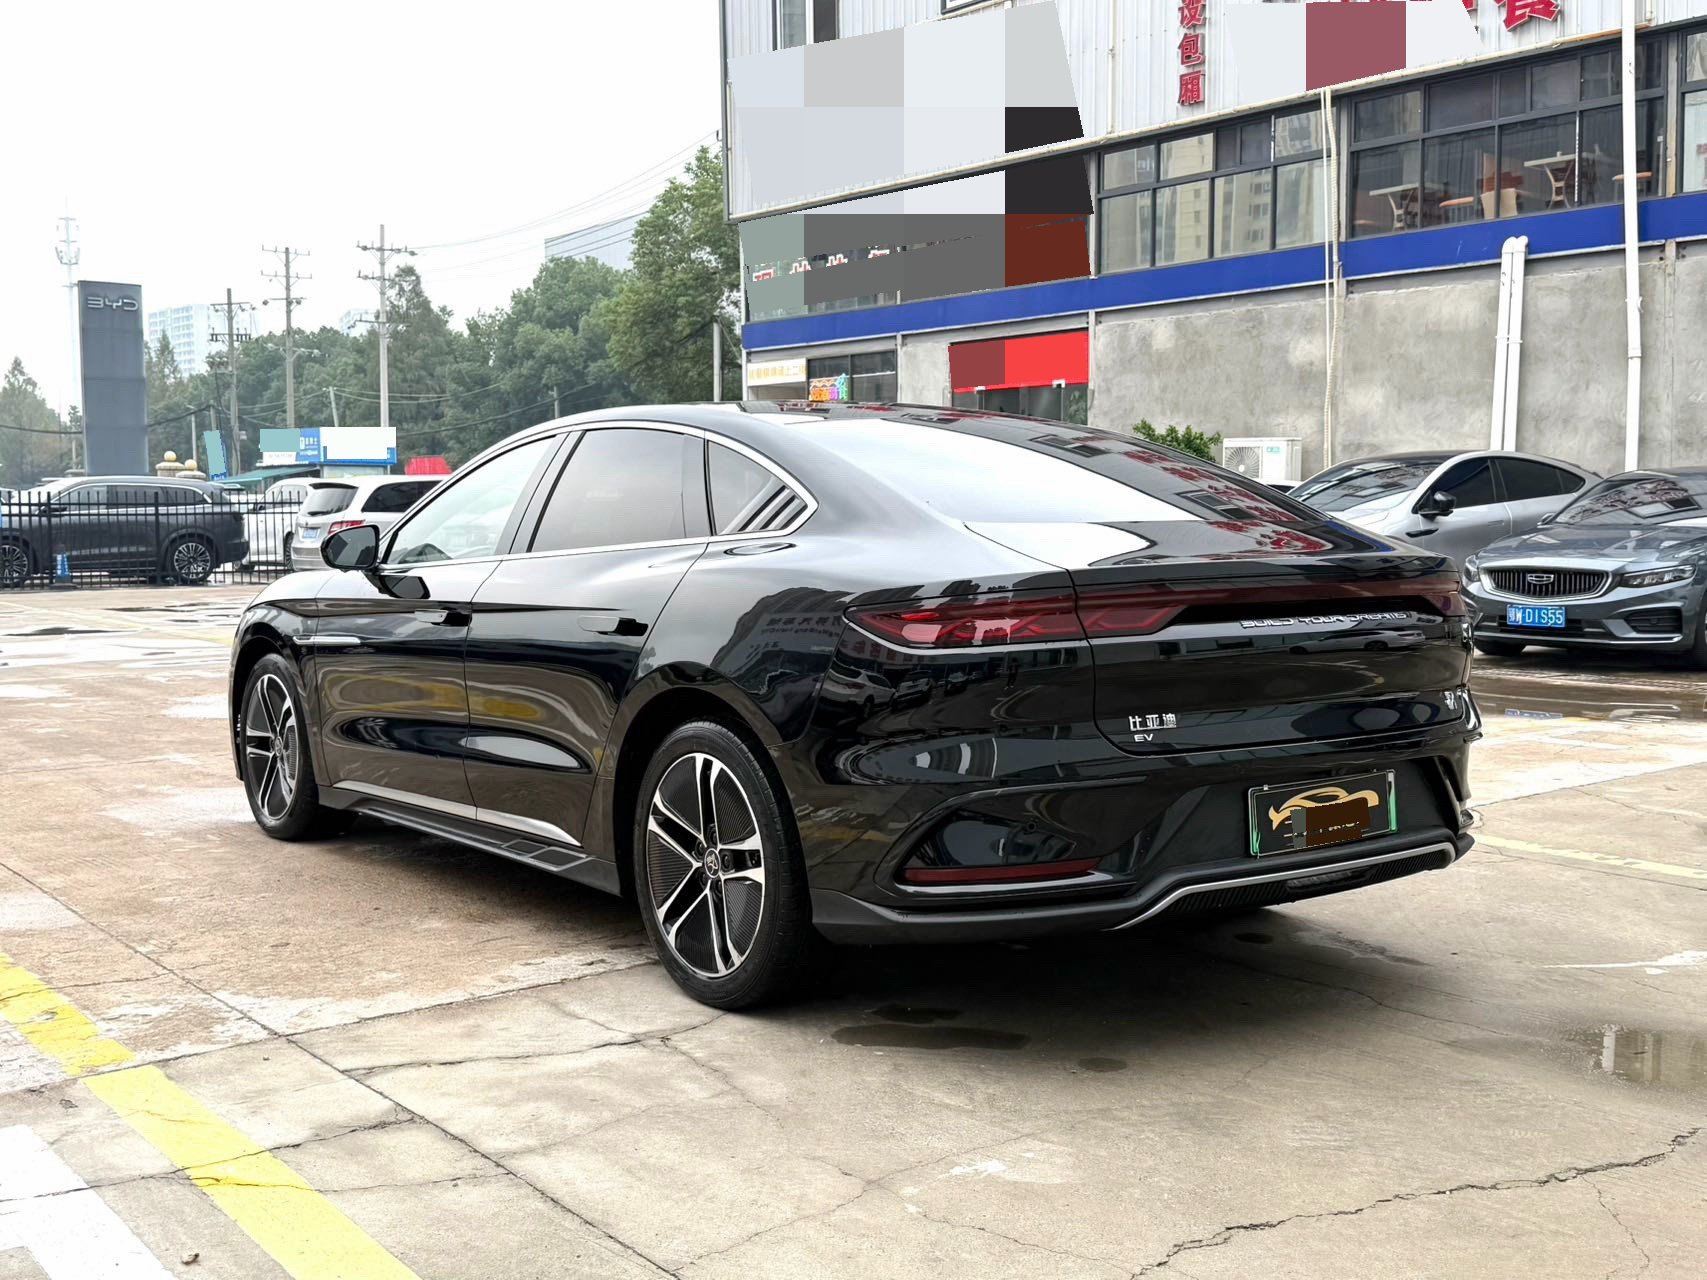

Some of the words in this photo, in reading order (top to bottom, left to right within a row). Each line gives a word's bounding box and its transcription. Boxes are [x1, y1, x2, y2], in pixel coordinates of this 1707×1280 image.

[87, 296, 138, 310] BYD
[1241, 619, 1294, 628] BUILD
[1128, 713, 1177, 731] 比亚迪
[1134, 733, 1153, 742] EV
